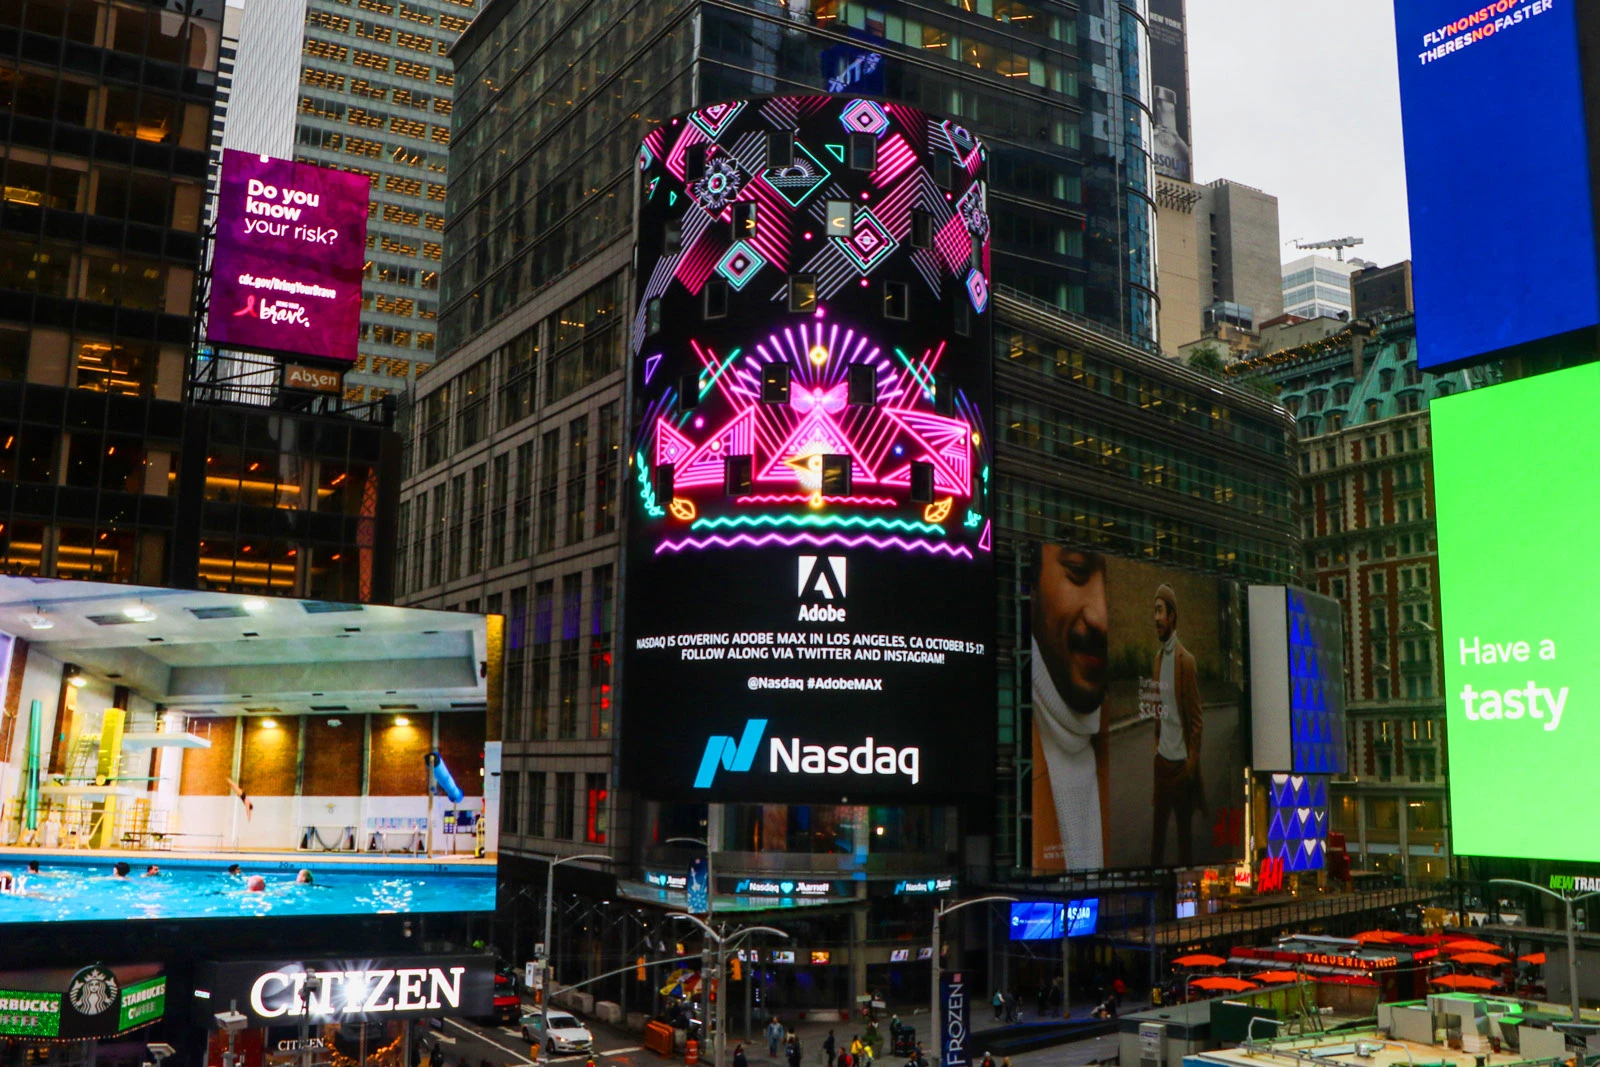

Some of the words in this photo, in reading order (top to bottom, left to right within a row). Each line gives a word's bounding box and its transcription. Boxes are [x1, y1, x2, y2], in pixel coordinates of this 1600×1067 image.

[1418, 0, 1552, 65] THERESNOFASTER
[1423, 0, 1525, 47] FLYNONSTOP
[248, 179, 277, 199] Do
[282, 187, 320, 207] you
[246, 196, 302, 221] know
[244, 217, 290, 237] your
[294, 224, 338, 245] risk?
[798, 604, 846, 622] Adobe
[636, 636, 666, 650] NASDAQ
[667, 635, 676, 646] IS
[677, 633, 729, 646] COVERING
[732, 633, 774, 645] ADOBE
[777, 633, 806, 645] MAX
[810, 633, 823, 645] IN
[827, 633, 850, 645] LOS
[853, 634, 907, 648] ANGELES,
[909, 636, 923, 648] CA
[925, 638, 964, 652] OCTOBER
[681, 648, 725, 660] FOLLOW
[727, 647, 768, 659] ALONG
[771, 647, 793, 659] VIA
[797, 647, 852, 660] TWITTER
[854, 648, 881, 661] AND
[884, 649, 945, 664] INSTAGRAM!
[1459, 636, 1530, 666] Have
[1539, 638, 1556, 660] a
[748, 677, 804, 692] @Nasdaq
[807, 677, 883, 691] #AdobeMAX
[1460, 680, 1569, 732] tasty
[770, 736, 920, 785] Nasdaq
[0, 877, 29, 895] LIX
[750, 882, 780, 894] Nasdaq
[121, 983, 165, 1008] STARBUCKS
[250, 967, 465, 1018] CITIZEN
[946, 983, 967, 1066] FROZEN
